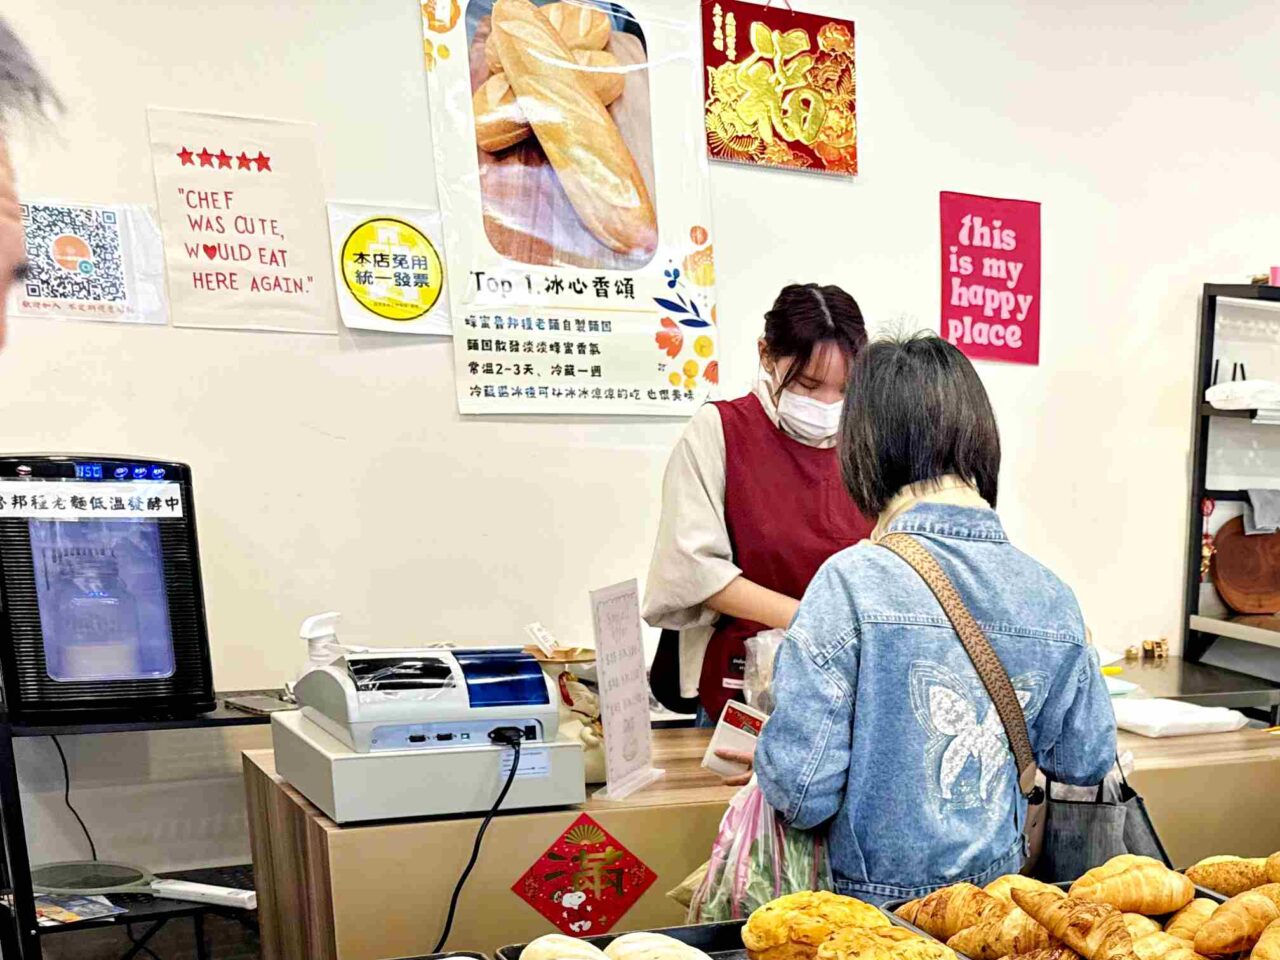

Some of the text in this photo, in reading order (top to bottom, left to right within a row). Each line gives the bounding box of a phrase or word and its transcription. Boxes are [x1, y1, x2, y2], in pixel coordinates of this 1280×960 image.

[189, 214, 285, 240] WAS CUTE,
[958, 213, 1016, 251] this
[259, 246, 288, 267] EAT
[352, 252, 428, 270] 本店免用
[949, 246, 1023, 288] is my
[193, 272, 238, 291] HERE
[355, 269, 430, 288] 統一發票
[470, 271, 513, 298] Top
[950, 277, 1033, 321] happy
[948, 317, 1023, 349] place
